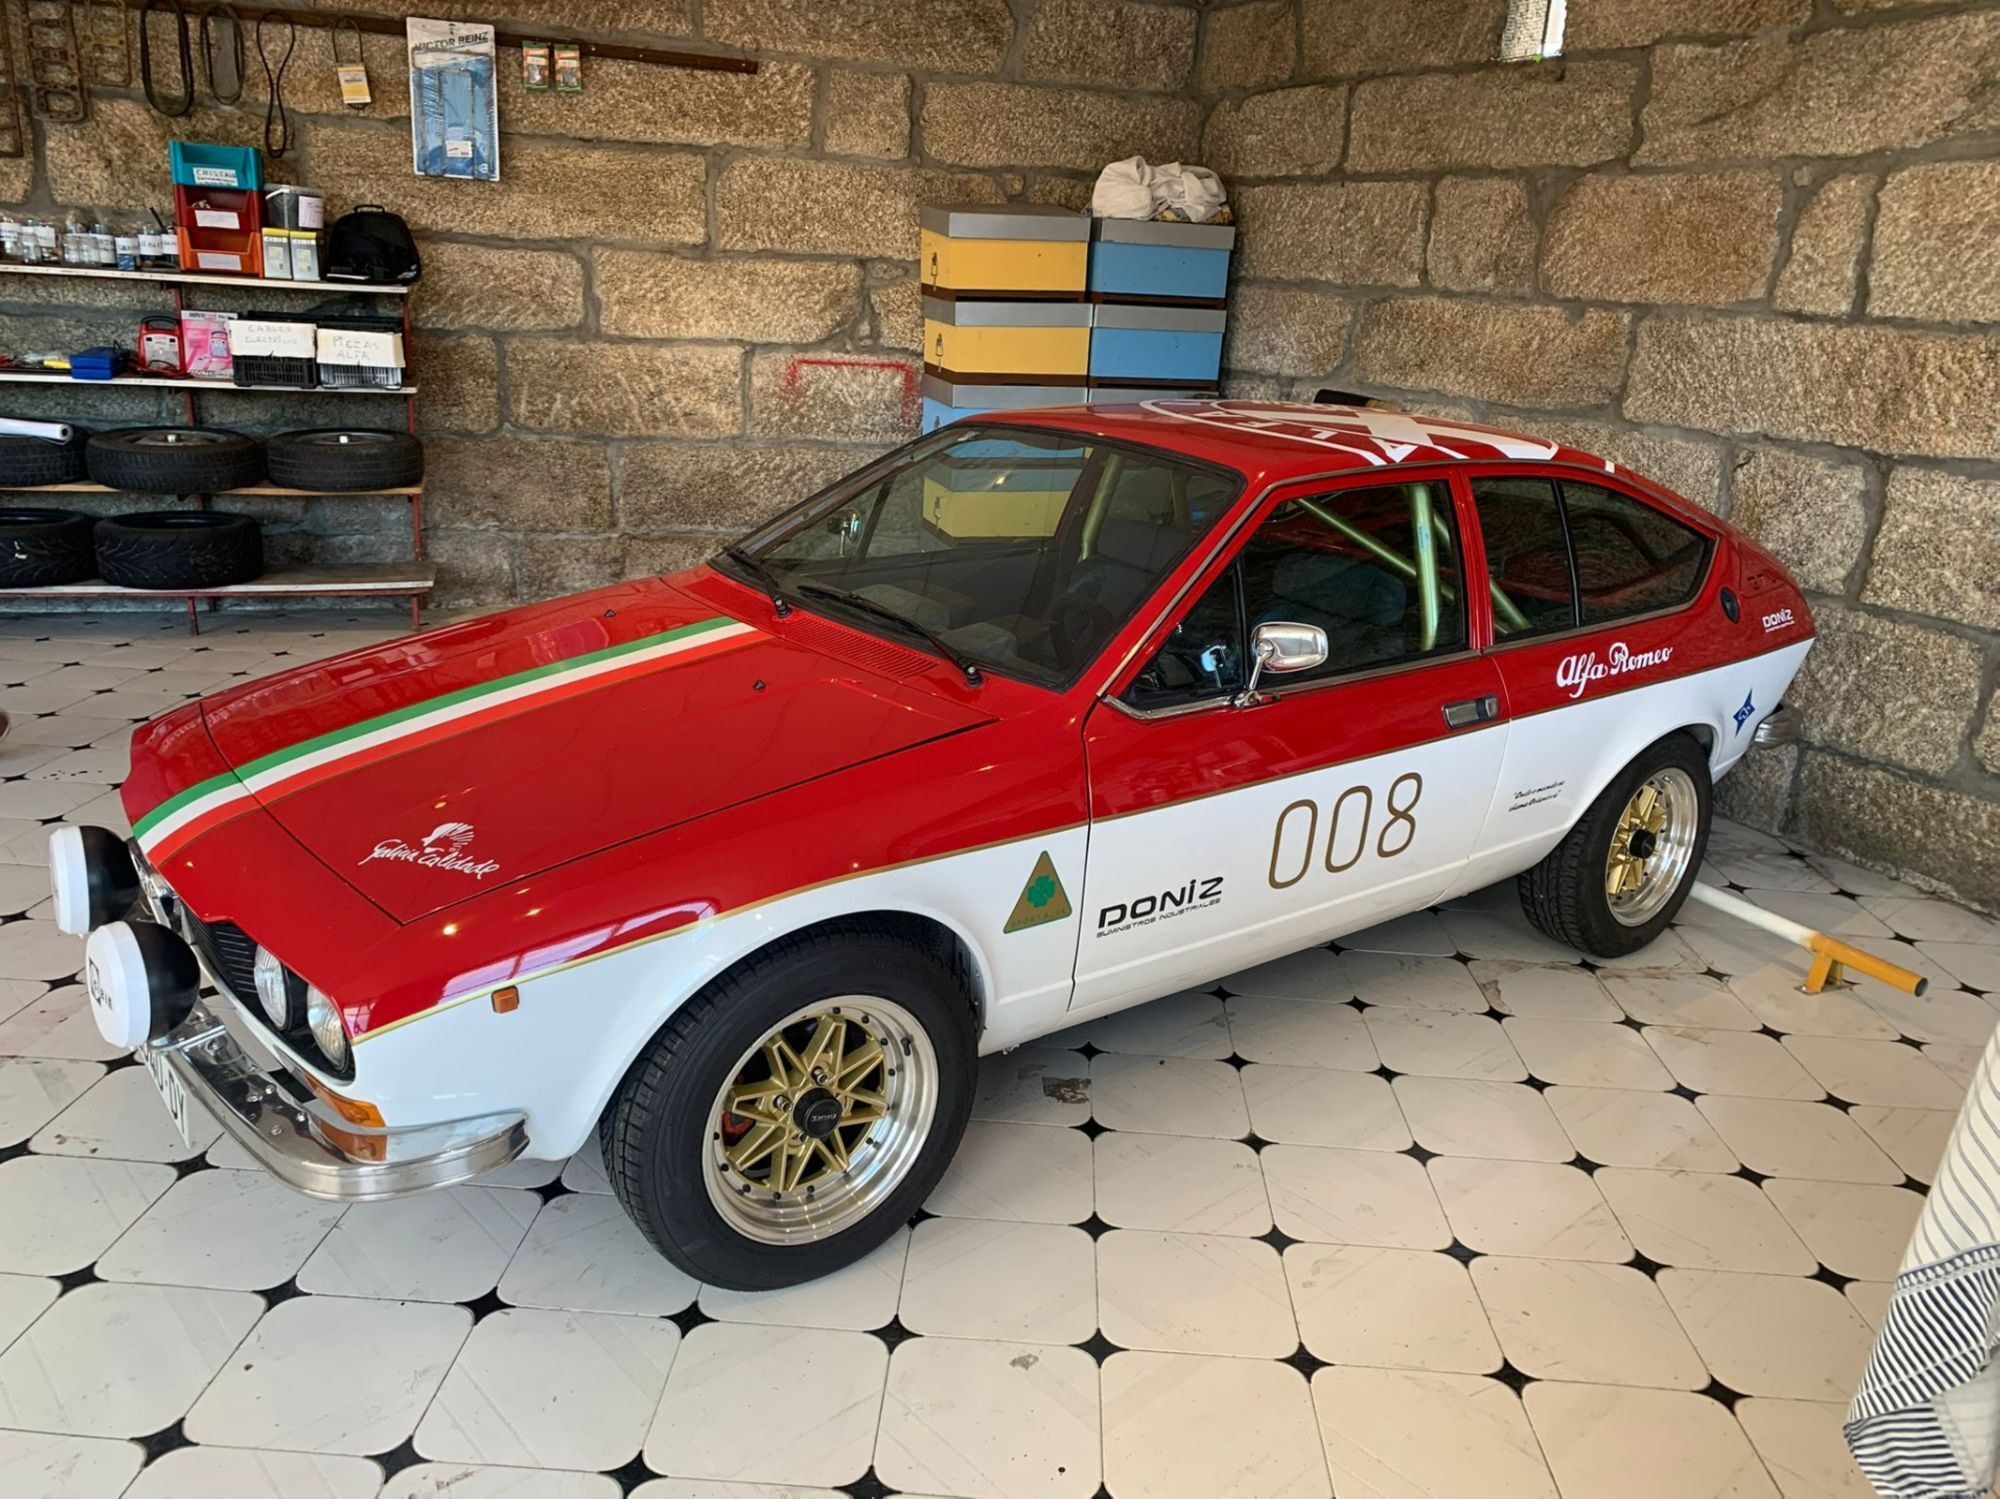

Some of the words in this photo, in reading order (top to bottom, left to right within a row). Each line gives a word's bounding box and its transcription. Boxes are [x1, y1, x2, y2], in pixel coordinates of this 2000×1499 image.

[458, 31, 489, 44] REINZ
[247, 324, 293, 333] CABLES
[332, 336, 381, 350] PIEZAS
[1556, 651, 1609, 698] Alfa
[1608, 642, 1674, 675] Romeo
[1269, 772, 1423, 889] 008
[1096, 917, 1157, 939] SUMINISTROS
